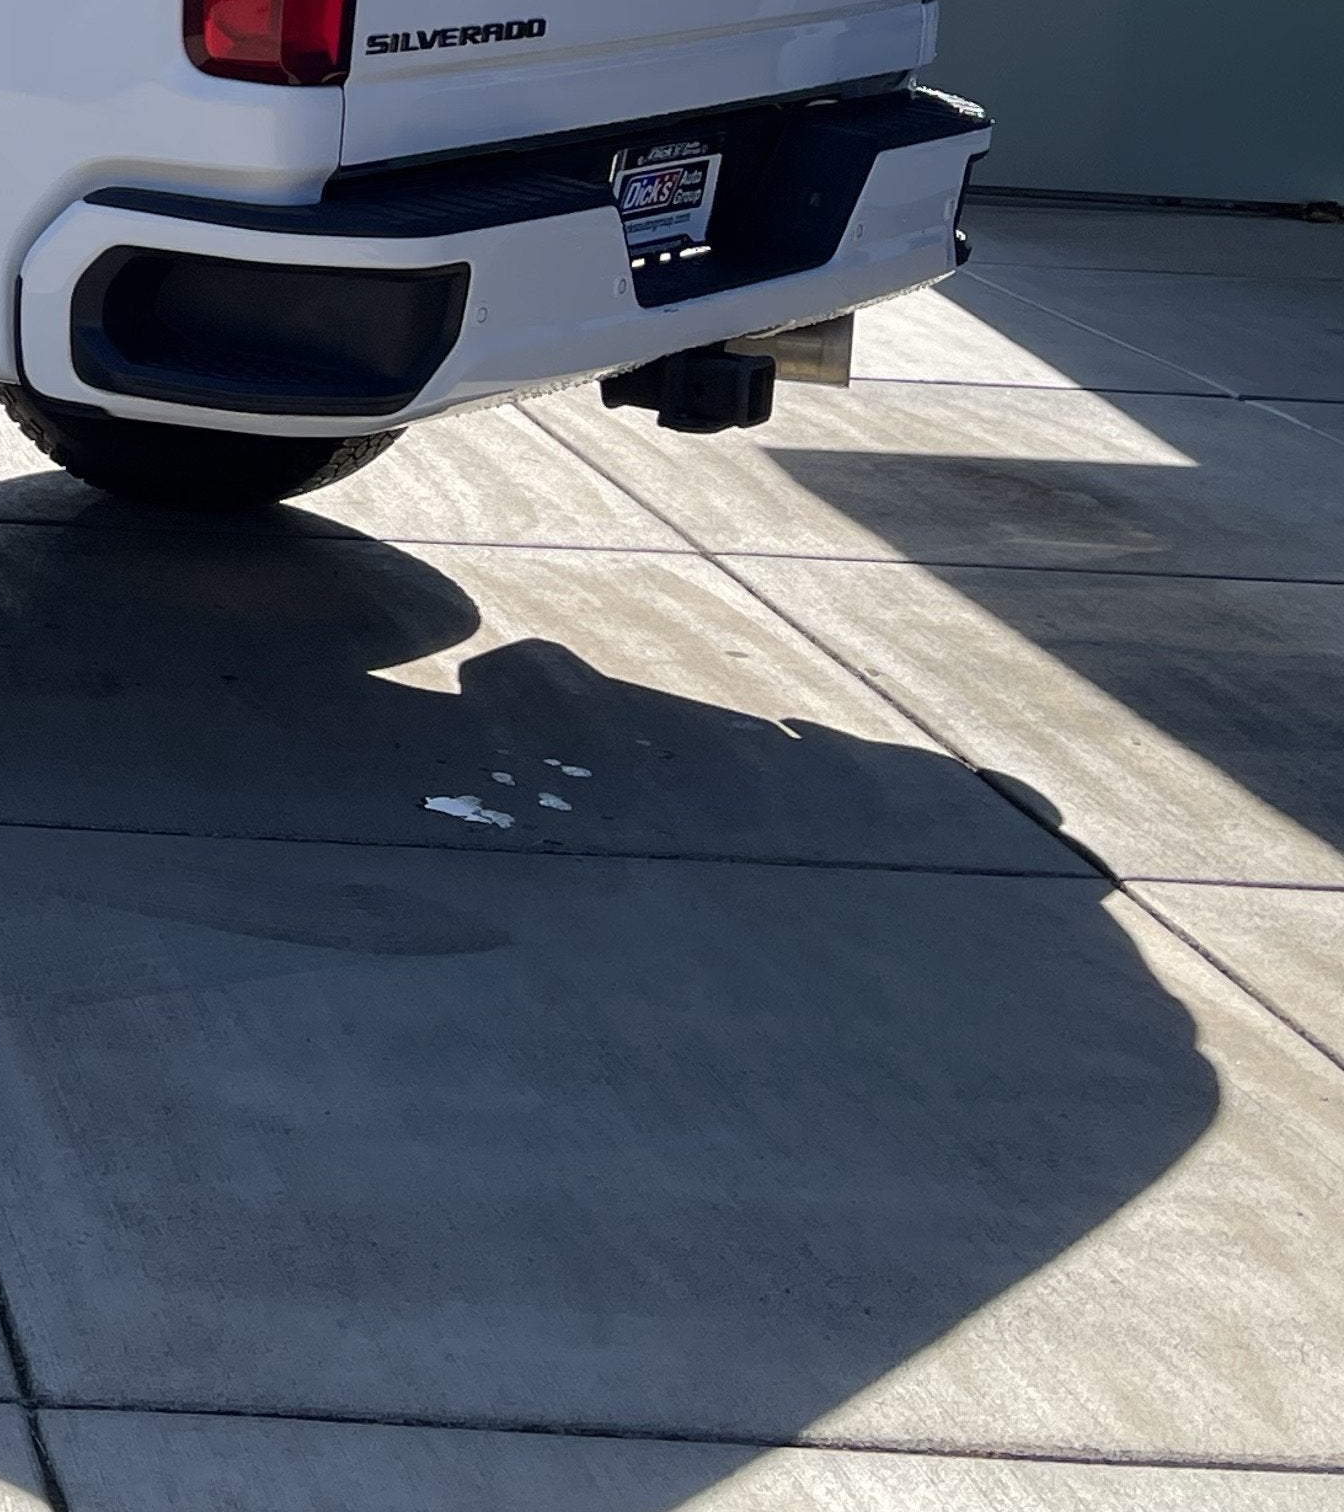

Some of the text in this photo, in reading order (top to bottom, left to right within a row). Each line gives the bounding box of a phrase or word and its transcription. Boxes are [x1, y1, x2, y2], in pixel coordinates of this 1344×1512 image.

[365, 17, 547, 56] SILVERADO
[679, 170, 702, 186] Auto
[623, 174, 674, 210] Dick's
[673, 189, 702, 205] Group
